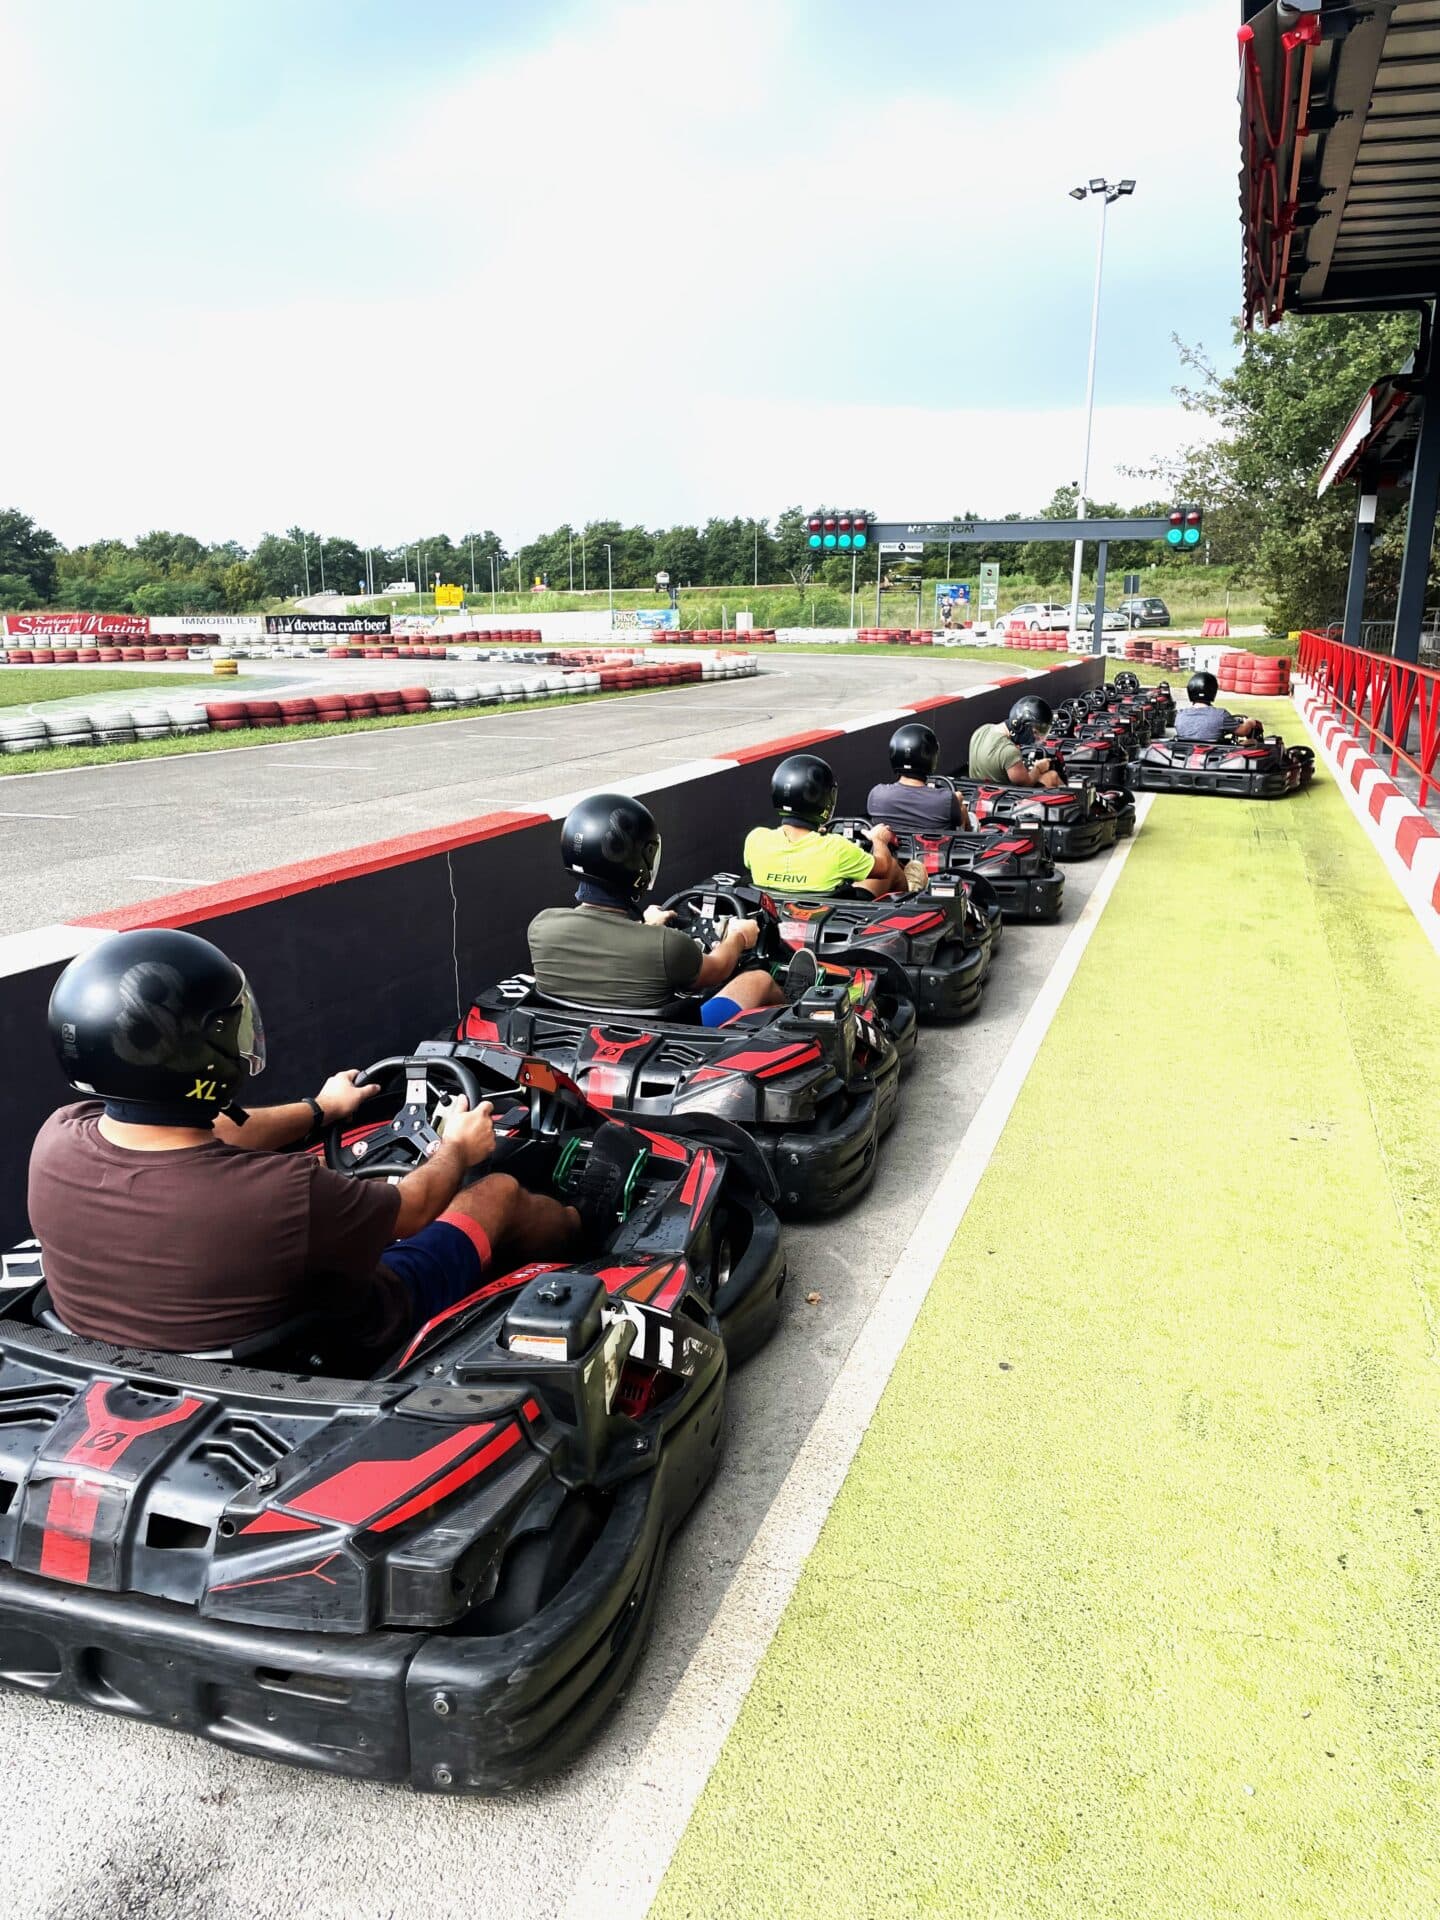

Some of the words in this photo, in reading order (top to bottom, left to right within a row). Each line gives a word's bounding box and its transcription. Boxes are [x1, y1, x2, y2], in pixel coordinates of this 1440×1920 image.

[13, 617, 70, 635] Santa
[74, 615, 147, 635] Marina
[181, 617, 257, 625] IMMOBILIEN
[294, 619, 336, 633] devetka
[338, 620, 363, 632] craft
[363, 618, 387, 633] beer
[766, 873, 808, 884] FERIVI
[185, 1079, 217, 1100] XL
